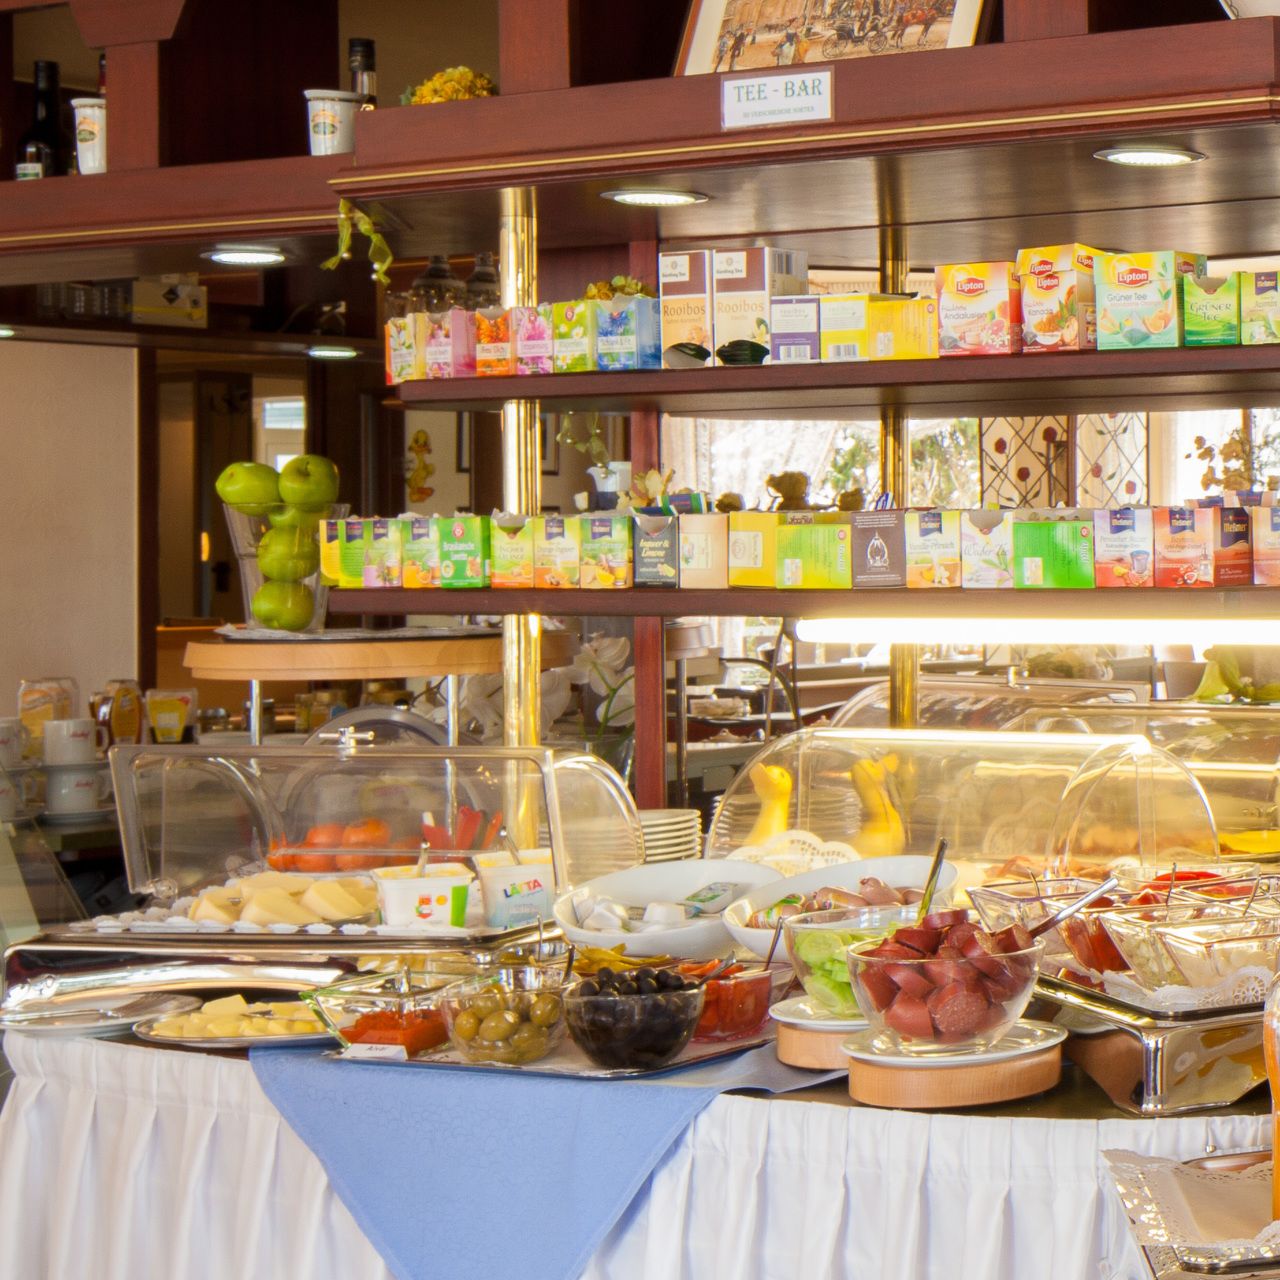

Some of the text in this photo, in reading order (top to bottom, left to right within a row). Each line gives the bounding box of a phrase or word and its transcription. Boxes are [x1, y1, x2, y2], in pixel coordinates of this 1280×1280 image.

[733, 83, 768, 102] TEE
[784, 78, 822, 98] BAR
[1030, 264, 1053, 274] Lipton
[1119, 272, 1148, 282] Lipton
[957, 281, 984, 292] Lipton
[1038, 278, 1059, 287] Lipton
[1106, 293, 1148, 302] Grüner Tee
[663, 304, 705, 317] Rooibos
[717, 300, 765, 314] Rooibos
[1190, 301, 1232, 312] GRÜNER
[944, 310, 987, 320] Andalusien
[1111, 518, 1133, 526] Meßmer
[1171, 518, 1192, 526] Meßmer
[1223, 523, 1247, 533] Meßmer
[503, 878, 543, 899] LÄTTA
